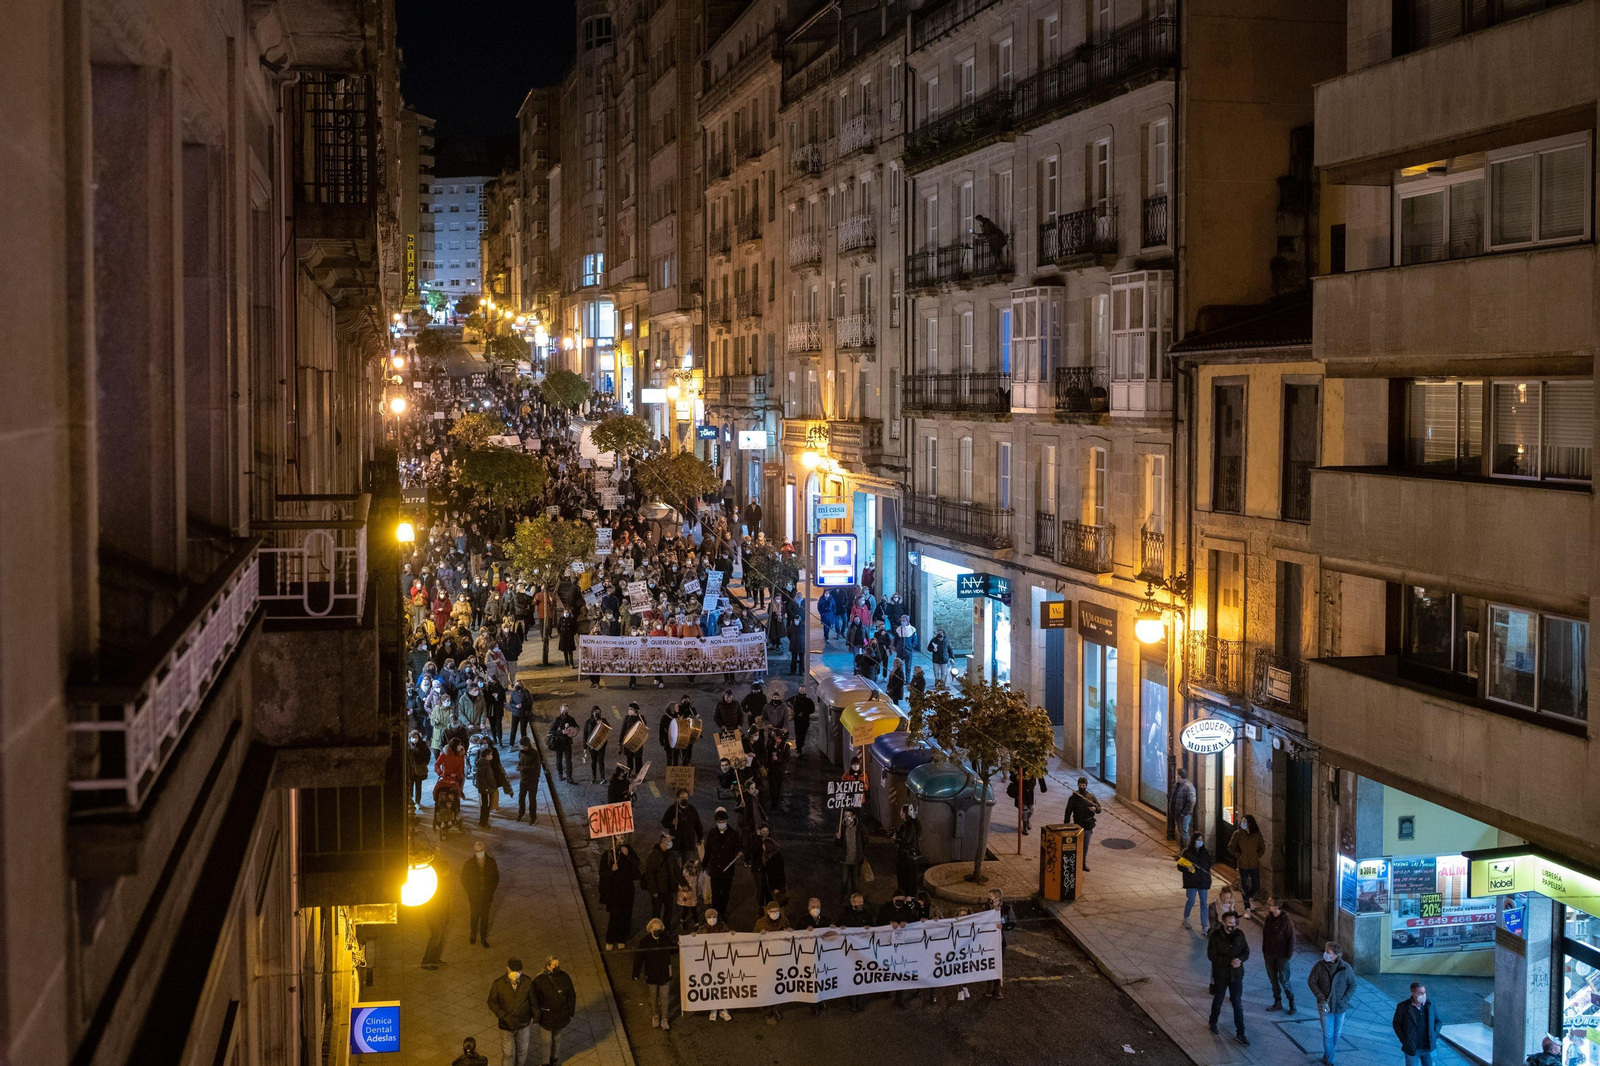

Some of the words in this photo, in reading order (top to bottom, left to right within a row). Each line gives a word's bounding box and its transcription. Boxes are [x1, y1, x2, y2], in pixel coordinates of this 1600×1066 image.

[1185, 721, 1232, 739] PELUQUERIA
[1186, 738, 1230, 752] MODERNA
[1440, 867, 1467, 877] ALM
[1542, 869, 1562, 882] LIBRERÍA
[1490, 879, 1513, 888] Nobel
[1542, 878, 1566, 893] PAPELERÍA
[1420, 904, 1441, 916] -20%
[1451, 915, 1472, 923] 466
[1476, 913, 1495, 921] 719
[934, 948, 966, 965] S.O.S
[854, 959, 890, 971] S.O.S
[933, 957, 996, 978] OURENSE
[688, 971, 725, 987] S.O.S
[776, 966, 811, 981] S.O.S
[853, 970, 918, 985] OURENSE
[774, 976, 838, 995] OURENSE
[687, 985, 758, 1002] OURENSE
[366, 1034, 396, 1042] Adeslas
